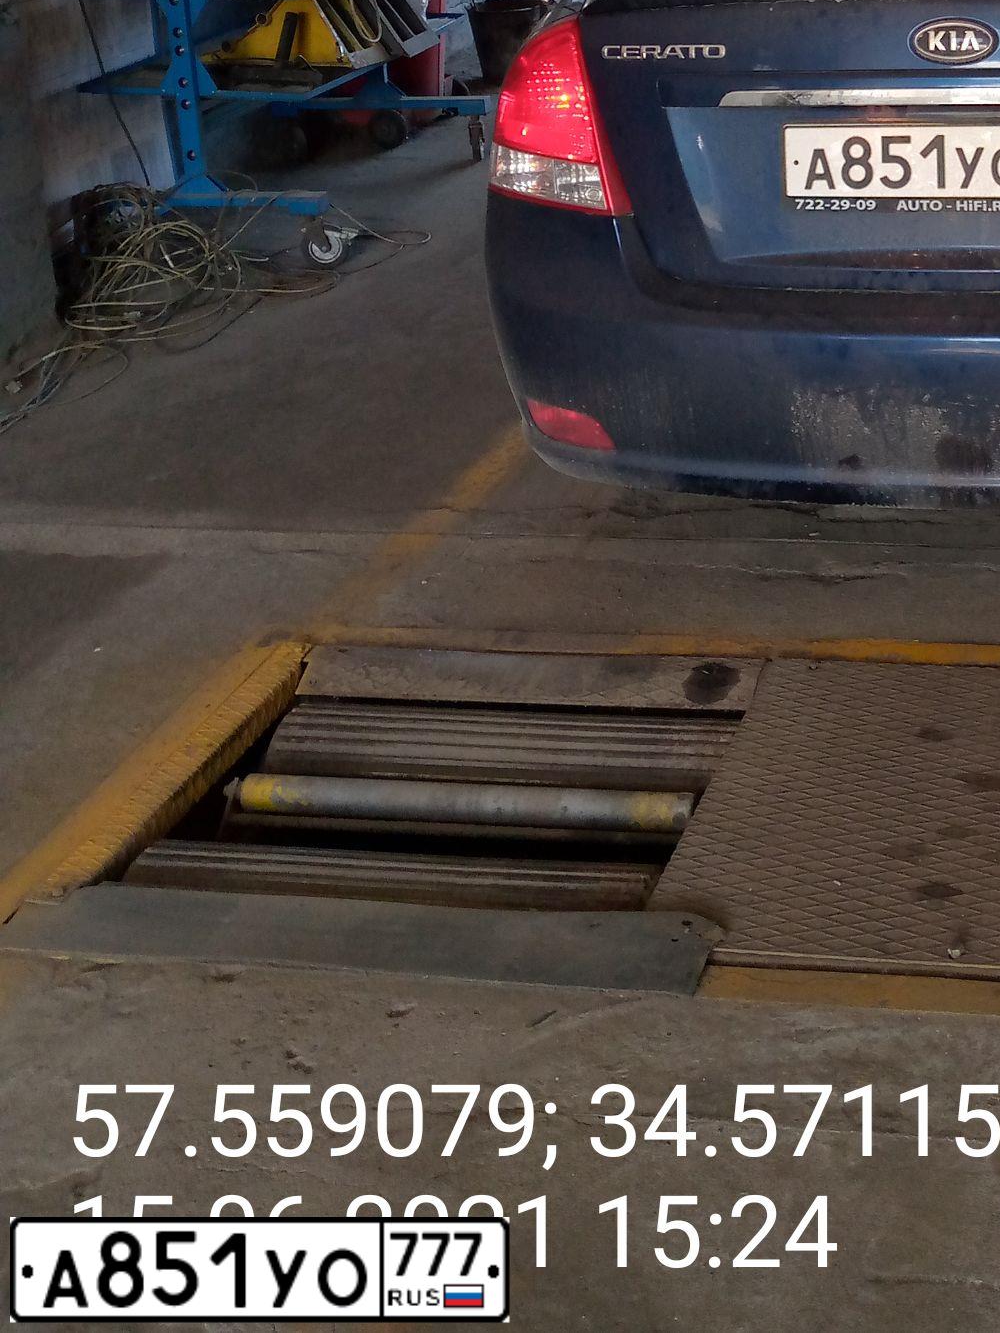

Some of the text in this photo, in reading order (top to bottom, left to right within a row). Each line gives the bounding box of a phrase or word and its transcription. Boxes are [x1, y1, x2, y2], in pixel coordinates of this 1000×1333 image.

[927, 30, 981, 52] KIA
[601, 44, 726, 60] CERATO
[794, 198, 877, 211] 722-29-09
